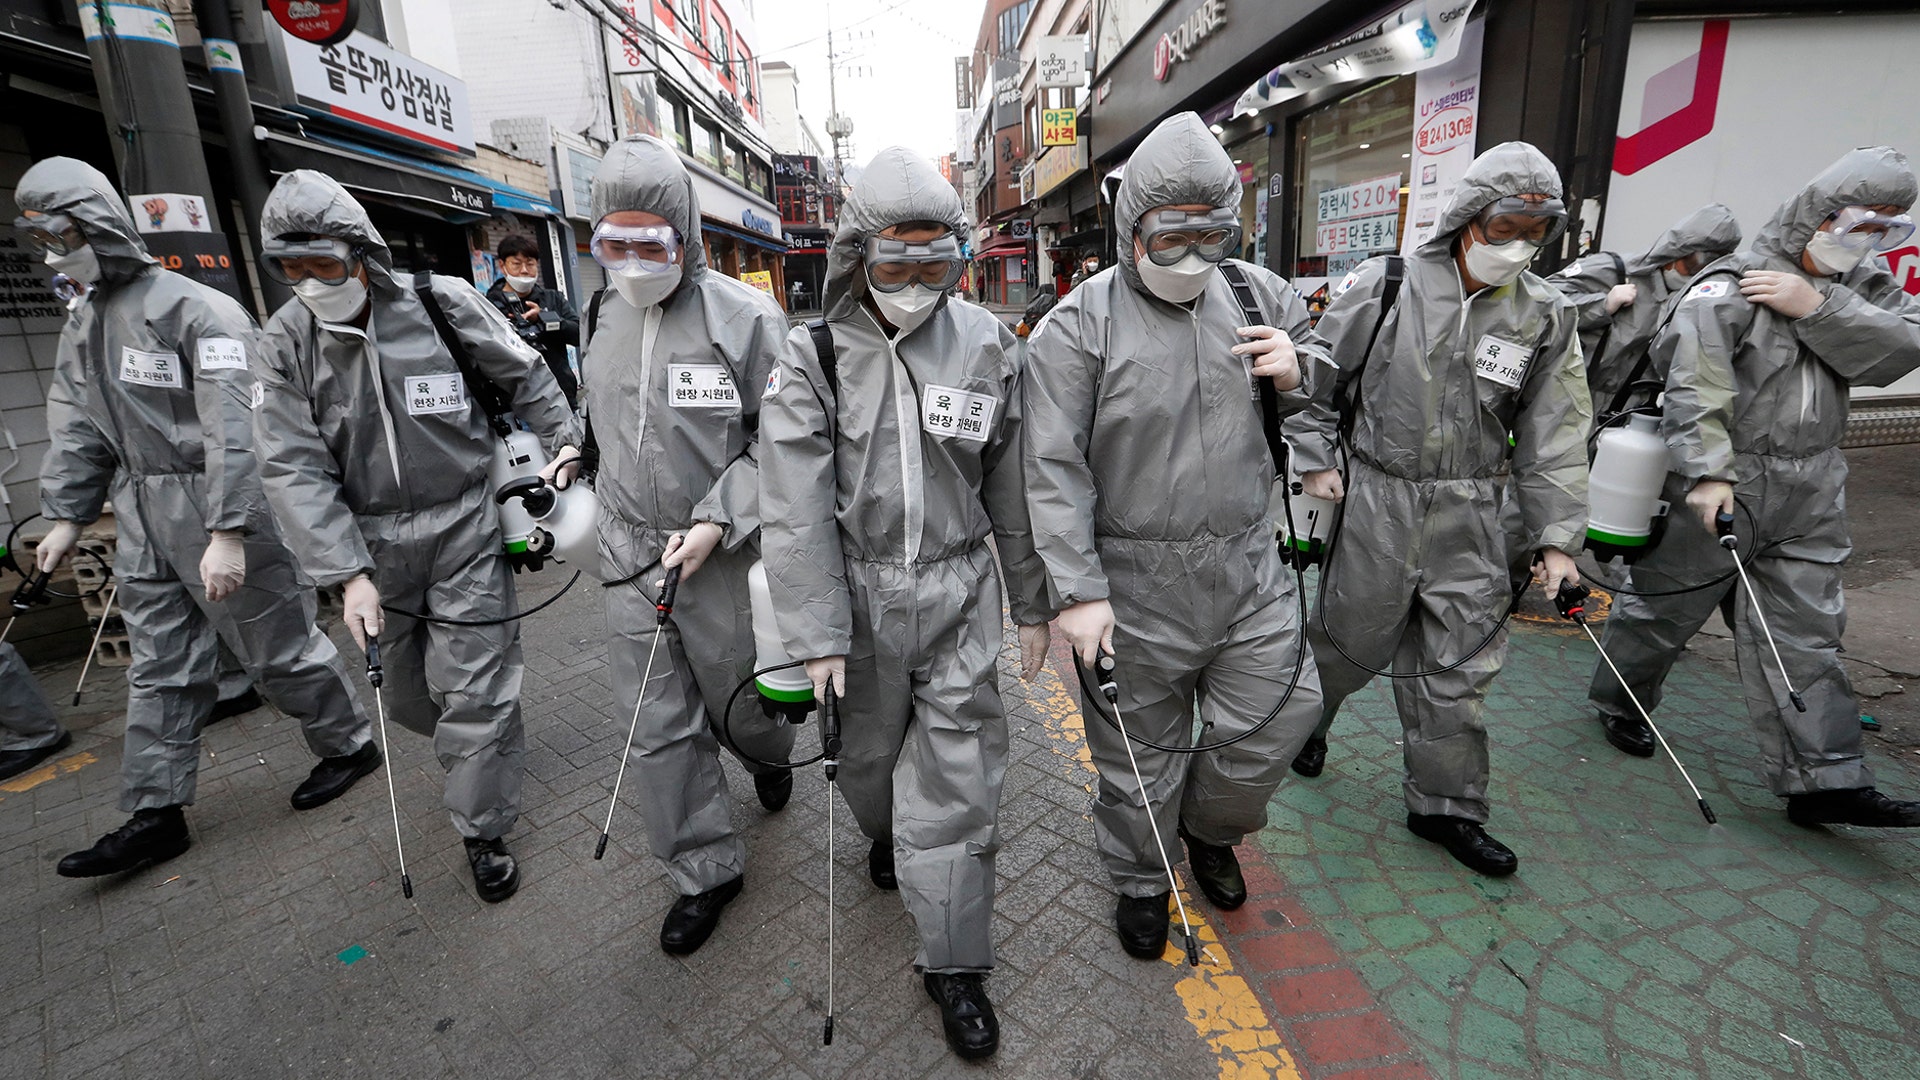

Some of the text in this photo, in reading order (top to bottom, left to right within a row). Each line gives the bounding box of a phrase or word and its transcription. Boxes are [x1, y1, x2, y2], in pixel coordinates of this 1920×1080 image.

[1168, 0, 1228, 64] SQUARE
[318, 44, 454, 132] 솥뚜껑삼겹살
[1045, 111, 1074, 126] 야구
[1045, 127, 1074, 142] 사격
[1319, 191, 1350, 219] 갤럭시
[1486, 344, 1501, 358] 육
[143, 371, 174, 382] 지원팀
[1475, 357, 1521, 381] 현장 지원
[679, 371, 693, 385] 육
[417, 382, 430, 394] 육
[675, 388, 734, 400] 현장 지원팀
[414, 397, 435, 408] 현장
[936, 395, 983, 417] 육 군
[928, 412, 982, 433] 현장 지원팀
